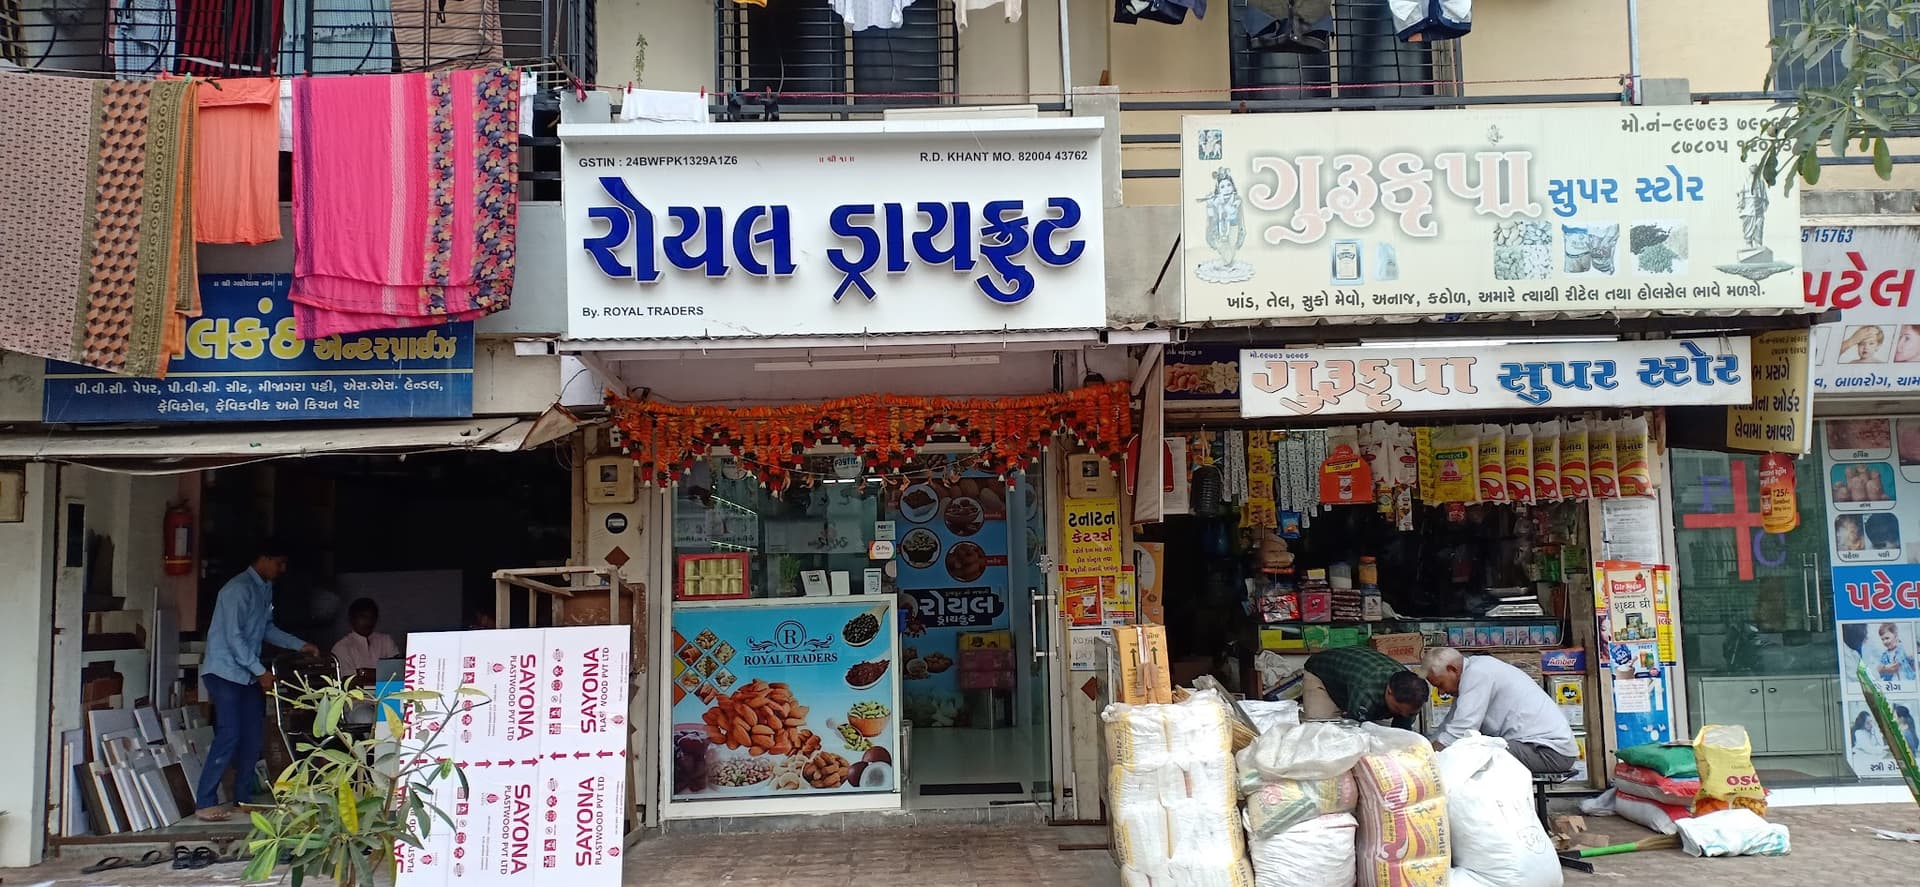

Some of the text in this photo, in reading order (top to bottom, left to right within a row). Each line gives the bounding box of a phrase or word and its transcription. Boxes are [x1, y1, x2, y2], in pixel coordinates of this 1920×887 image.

[578, 157, 615, 168] GSTIN
[625, 156, 738, 167] 24BWFPK1329A1Z6
[919, 150, 1088, 162] R.D. KHANT MO. 82004 43762
[1548, 175, 1618, 216] સુપર
[1635, 165, 1704, 202] સ્ટોર
[584, 176, 799, 284] રોયલ
[1815, 228, 1853, 243] 15763
[1803, 252, 1915, 310] પટેલ
[1226, 291, 1259, 311] ખાંડ,
[1266, 291, 1295, 310] તેલ,
[1302, 290, 1329, 312] સુકો
[1335, 289, 1365, 308] મેવો,
[1372, 293, 1421, 307] અનાજ,
[1427, 288, 1471, 306] કઠોળ,
[1478, 286, 1516, 303] અમારે
[1565, 284, 1599, 302] રીટેલ
[1605, 287, 1631, 301] તથા
[1637, 282, 1686, 300] હોલસેલ
[1693, 281, 1721, 298] ભાવે
[1726, 280, 1766, 297] મળશે.
[582, 306, 704, 318] By. ROYAL TRADERS
[172, 297, 305, 360] લકંઠ
[132, 380, 162, 395] પેપર,
[225, 380, 252, 395] સીટ,
[343, 378, 398, 391] એસ.એસ.
[404, 377, 444, 392] હેન્ડલ,
[1497, 360, 1619, 405] સુપર
[1637, 340, 1741, 387] સ્ટોર
[1835, 373, 1891, 388] બાળરોગ,
[157, 398, 209, 414] ફેવિકોલ,
[276, 398, 299, 411] અને
[304, 397, 338, 410] કિચન
[344, 397, 360, 410] વેર
[1772, 389, 1800, 412] ઓર્ડર
[1734, 415, 1795, 442] લેવામાં આવશે
[1068, 511, 1115, 527] ટનાટન
[919, 590, 994, 616] રોયલ
[783, 629, 797, 645] R
[744, 652, 838, 665] ROYAL TRADERS
[508, 655, 517, 707] PLASTWOOD
[581, 647, 599, 734] SAYONA
[517, 654, 536, 741] SAYONA
[600, 680, 609, 733] PLASOOD
[502, 785, 512, 840] PLASTWOOD
[596, 793, 604, 808] PVT
[511, 784, 531, 875] SAYONA
[576, 776, 595, 866] SAYONA
[594, 811, 604, 866] PLASTWOOD
